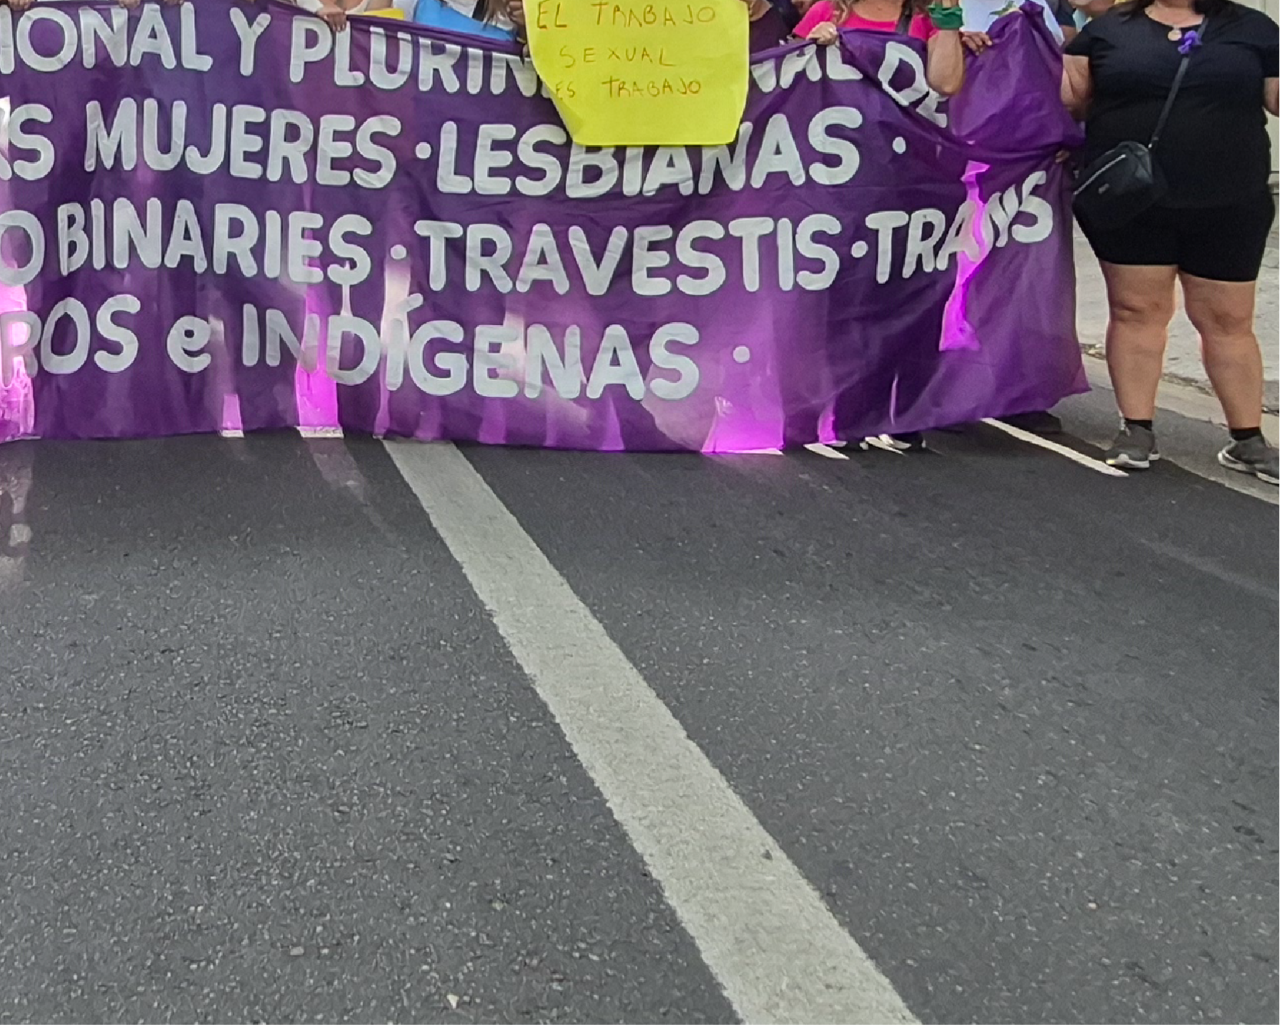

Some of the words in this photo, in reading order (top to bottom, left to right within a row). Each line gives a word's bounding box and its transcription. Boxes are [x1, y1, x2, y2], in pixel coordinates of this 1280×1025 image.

[229, 7, 271, 76] Y
[559, 44, 677, 68] SEXUAL
[554, 79, 576, 100] ES
[601, 75, 702, 98] TRABAJO
[84, 97, 402, 189] MUJERES
[436, 106, 863, 199] LESBIANAS
[56, 197, 373, 286] BINARIES
[414, 214, 842, 296] TRAVESTIS
[865, 171, 1054, 284] TRANS
[166, 315, 212, 373] e
[241, 292, 700, 401] INDÍGENAS
